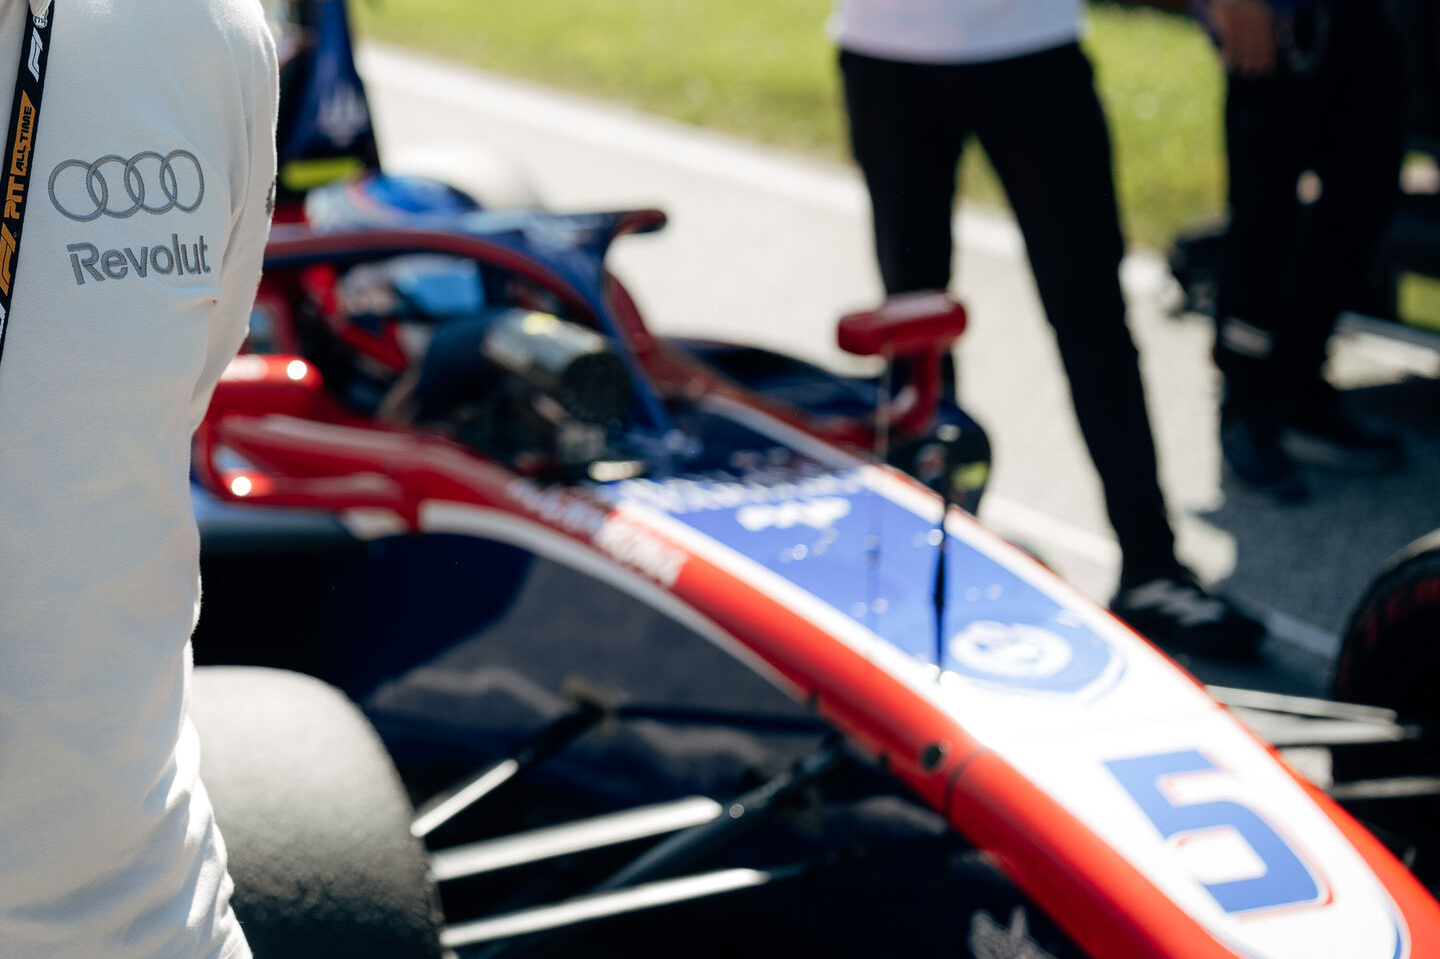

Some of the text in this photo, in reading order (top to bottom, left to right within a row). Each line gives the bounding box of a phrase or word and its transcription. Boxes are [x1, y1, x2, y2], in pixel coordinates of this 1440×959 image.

[3, 176, 25, 220] PIT
[15, 147, 27, 172] ALL
[21, 106, 33, 143] TIME
[66, 233, 211, 285] Revolut
[1102, 748, 1333, 918] 5
